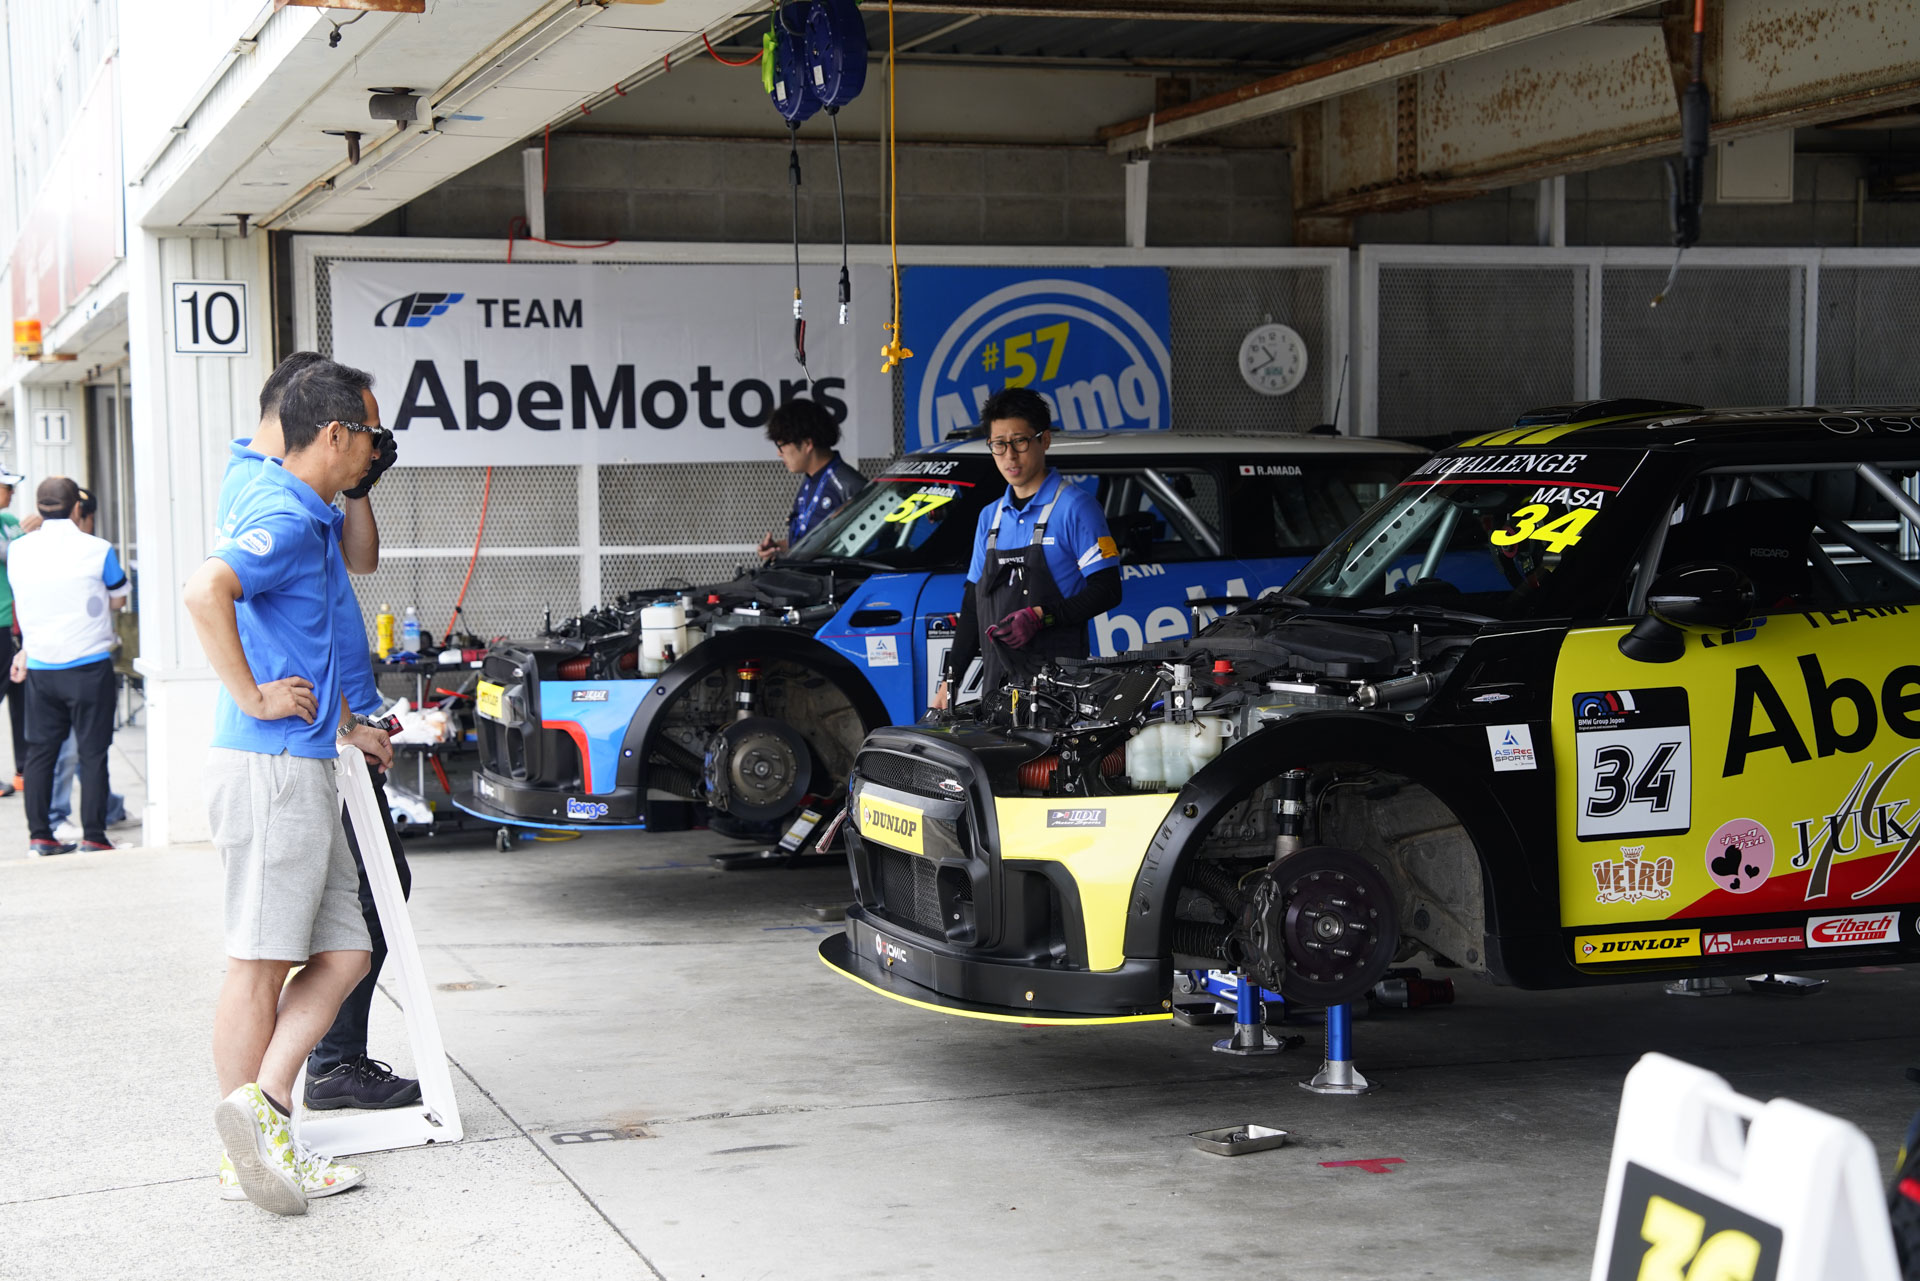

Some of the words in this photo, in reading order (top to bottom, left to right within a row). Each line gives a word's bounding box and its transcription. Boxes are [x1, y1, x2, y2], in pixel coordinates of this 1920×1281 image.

[181, 291, 240, 345] 10
[477, 299, 583, 328] TEAM
[982, 321, 1069, 389] #57
[392, 360, 848, 431] AbeMotors
[936, 363, 1160, 438] Amo
[41, 415, 67, 440] 11
[1257, 466, 1302, 476] R.AMADA
[1437, 454, 1588, 474] CHALLENGE
[883, 493, 953, 524] 57
[1529, 487, 1605, 509] MASA
[1490, 503, 1600, 554] 34
[1120, 563, 1166, 581] AM
[1593, 718, 1608, 726] Group
[1722, 653, 1920, 778] Abe
[1494, 754, 1534, 762] SPORTS
[1586, 742, 1682, 817] 34
[872, 809, 917, 838] DUNLOP
[1069, 810, 1102, 821] IDI
[1720, 828, 1758, 845] ジューク
[1735, 835, 1765, 850] ジェル
[1593, 857, 1674, 893] VETRO
[1733, 938, 1752, 946] J&A
[1752, 935, 1788, 945] RACING
[1788, 934, 1803, 943] OIL
[1812, 915, 1892, 942] Eibach
[1600, 937, 1690, 953] DUNLOP
